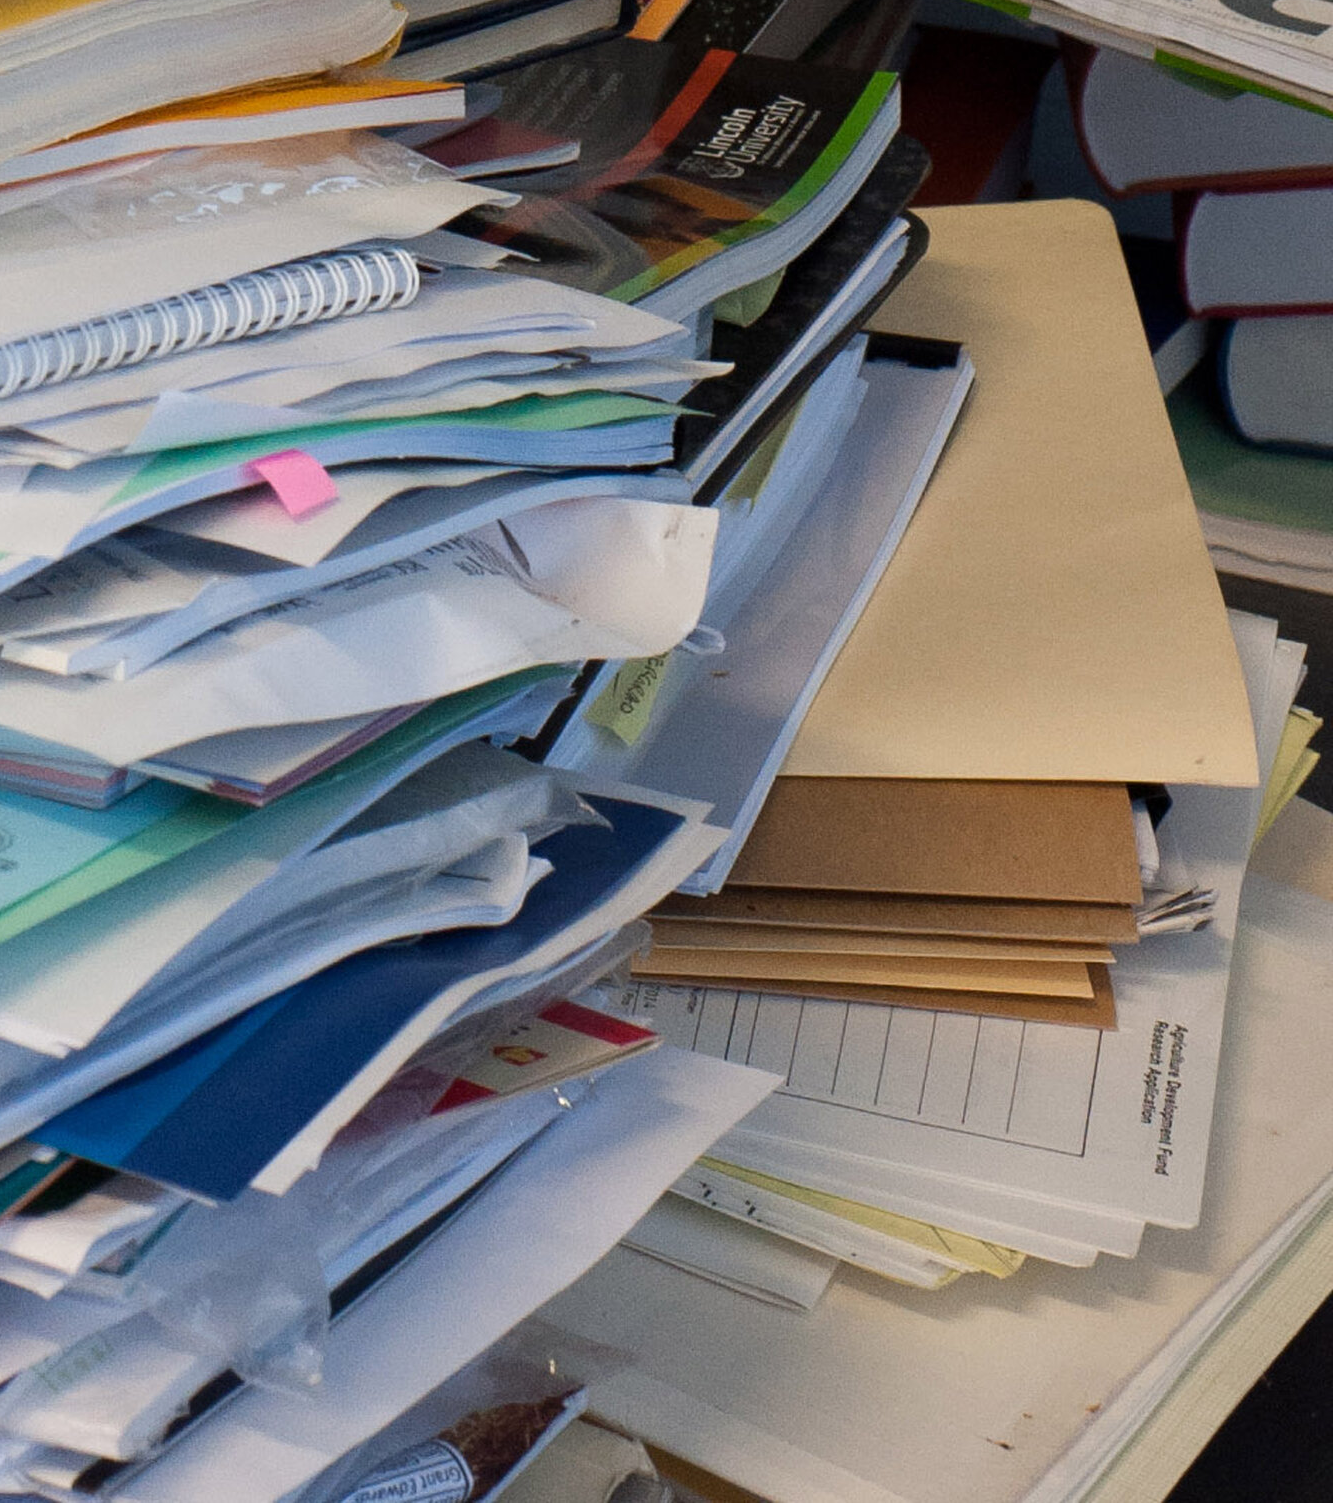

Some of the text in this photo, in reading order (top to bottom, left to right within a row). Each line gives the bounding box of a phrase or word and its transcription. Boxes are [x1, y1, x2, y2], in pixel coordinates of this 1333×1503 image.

[692, 106, 758, 159] Lincoln
[725, 94, 808, 165] University
[1149, 1019, 1167, 1067] Research
[1153, 1024, 1189, 1178] Agriculture Development Fund
[418, 1465, 462, 1493] Grant
